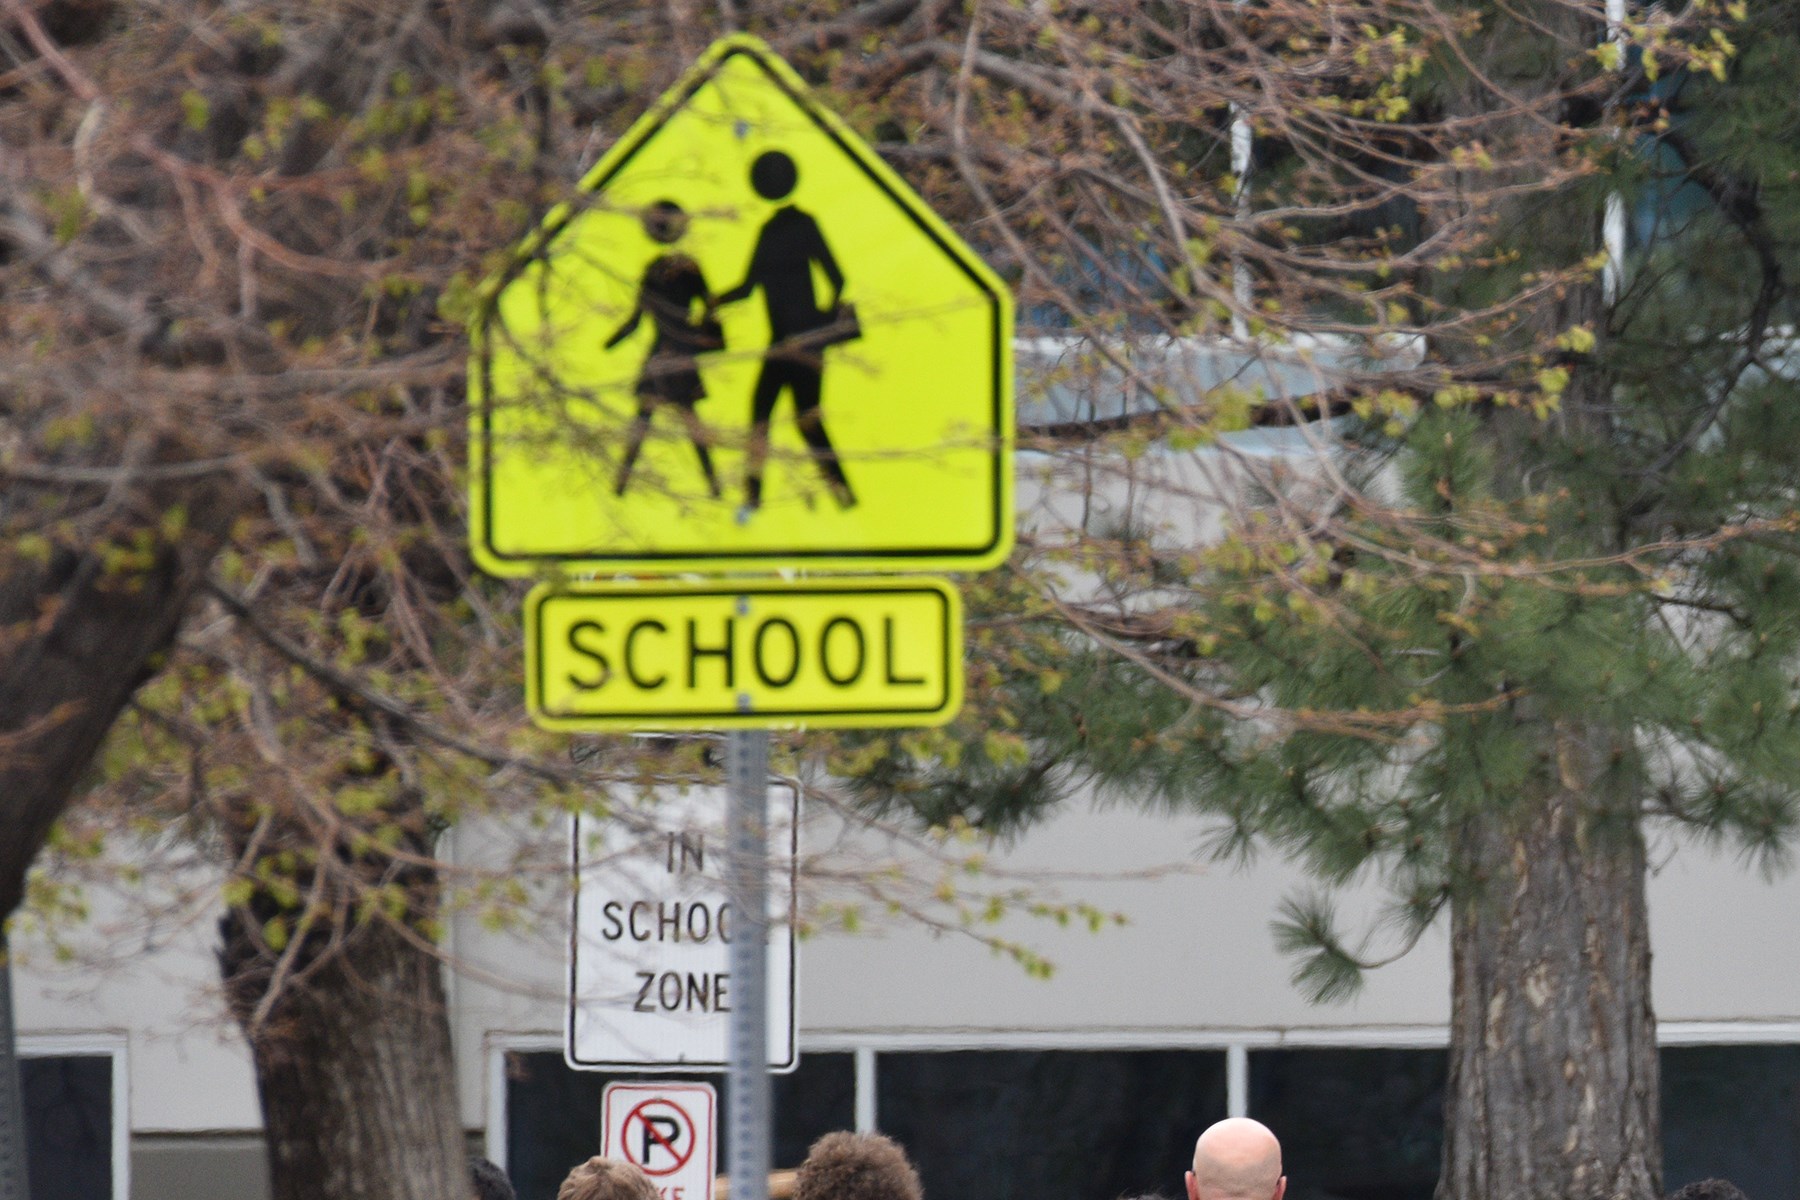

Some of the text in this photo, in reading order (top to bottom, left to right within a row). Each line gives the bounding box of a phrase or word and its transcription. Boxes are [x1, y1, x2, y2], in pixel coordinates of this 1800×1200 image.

[565, 616, 928, 692] SCHOOL
[665, 831, 705, 874] IN
[633, 971, 733, 1013] ZONE
